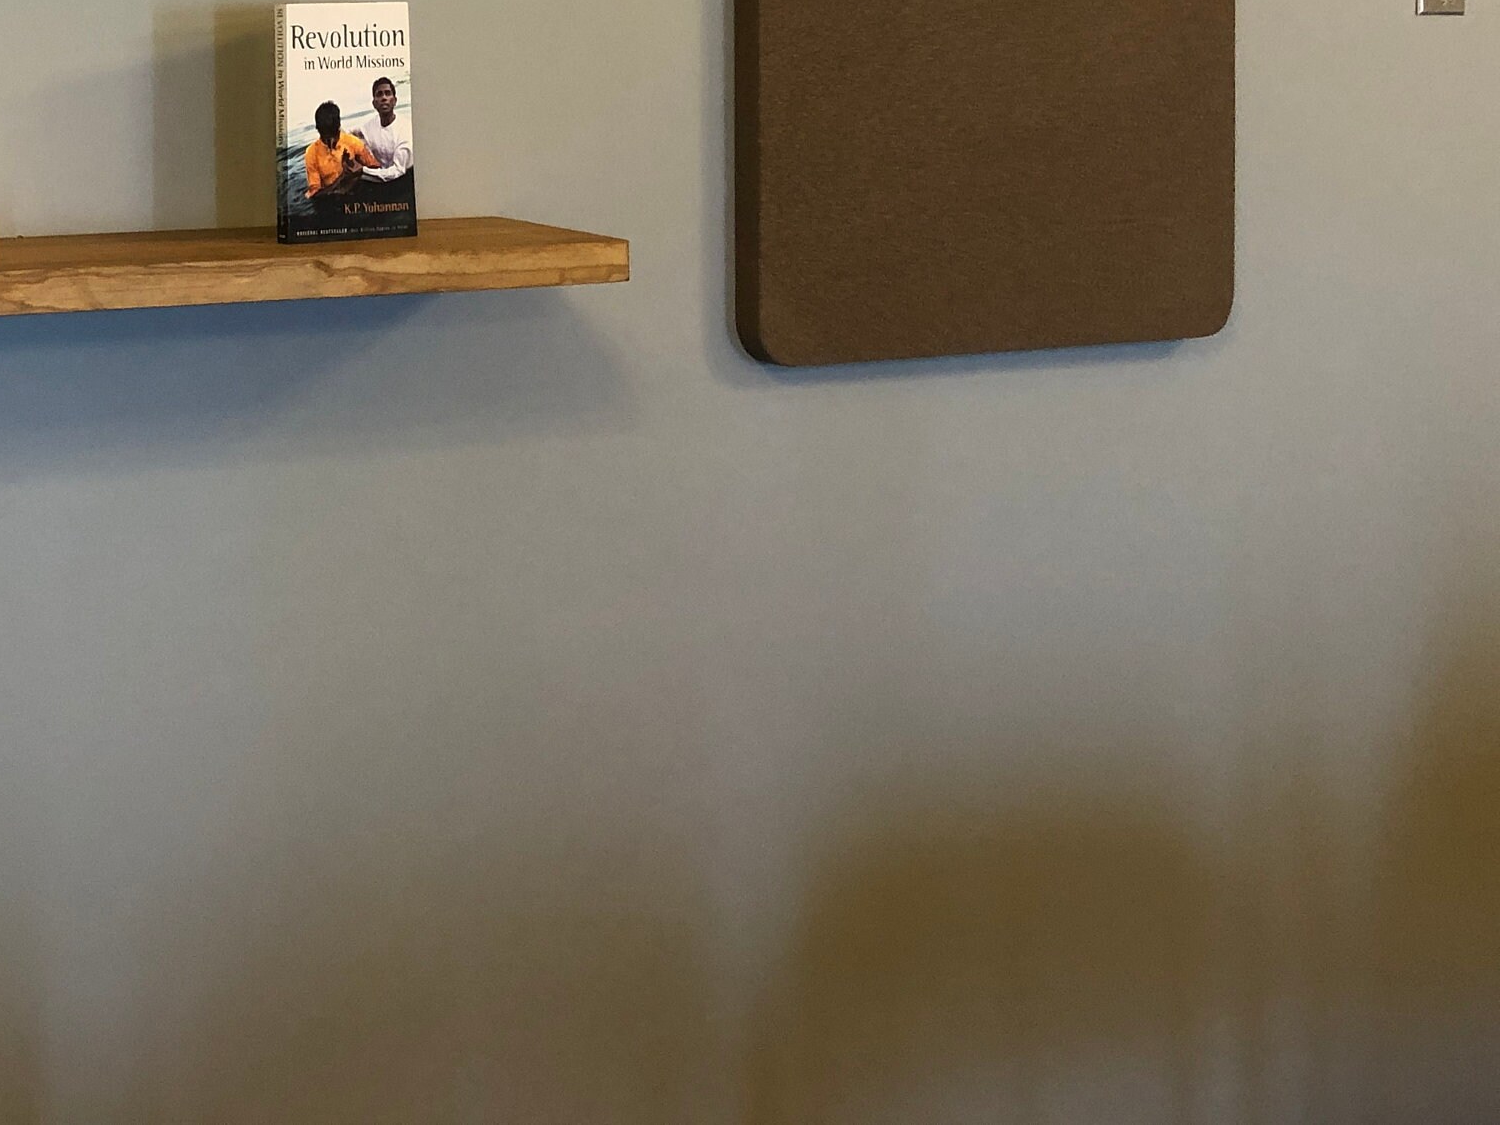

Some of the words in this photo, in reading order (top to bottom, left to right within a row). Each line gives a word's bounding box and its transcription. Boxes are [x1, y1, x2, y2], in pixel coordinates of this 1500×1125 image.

[290, 23, 405, 50] Revolution
[304, 57, 315, 70] in
[318, 55, 353, 70] World
[356, 55, 405, 69] Missions
[362, 201, 409, 214] Yohannan
